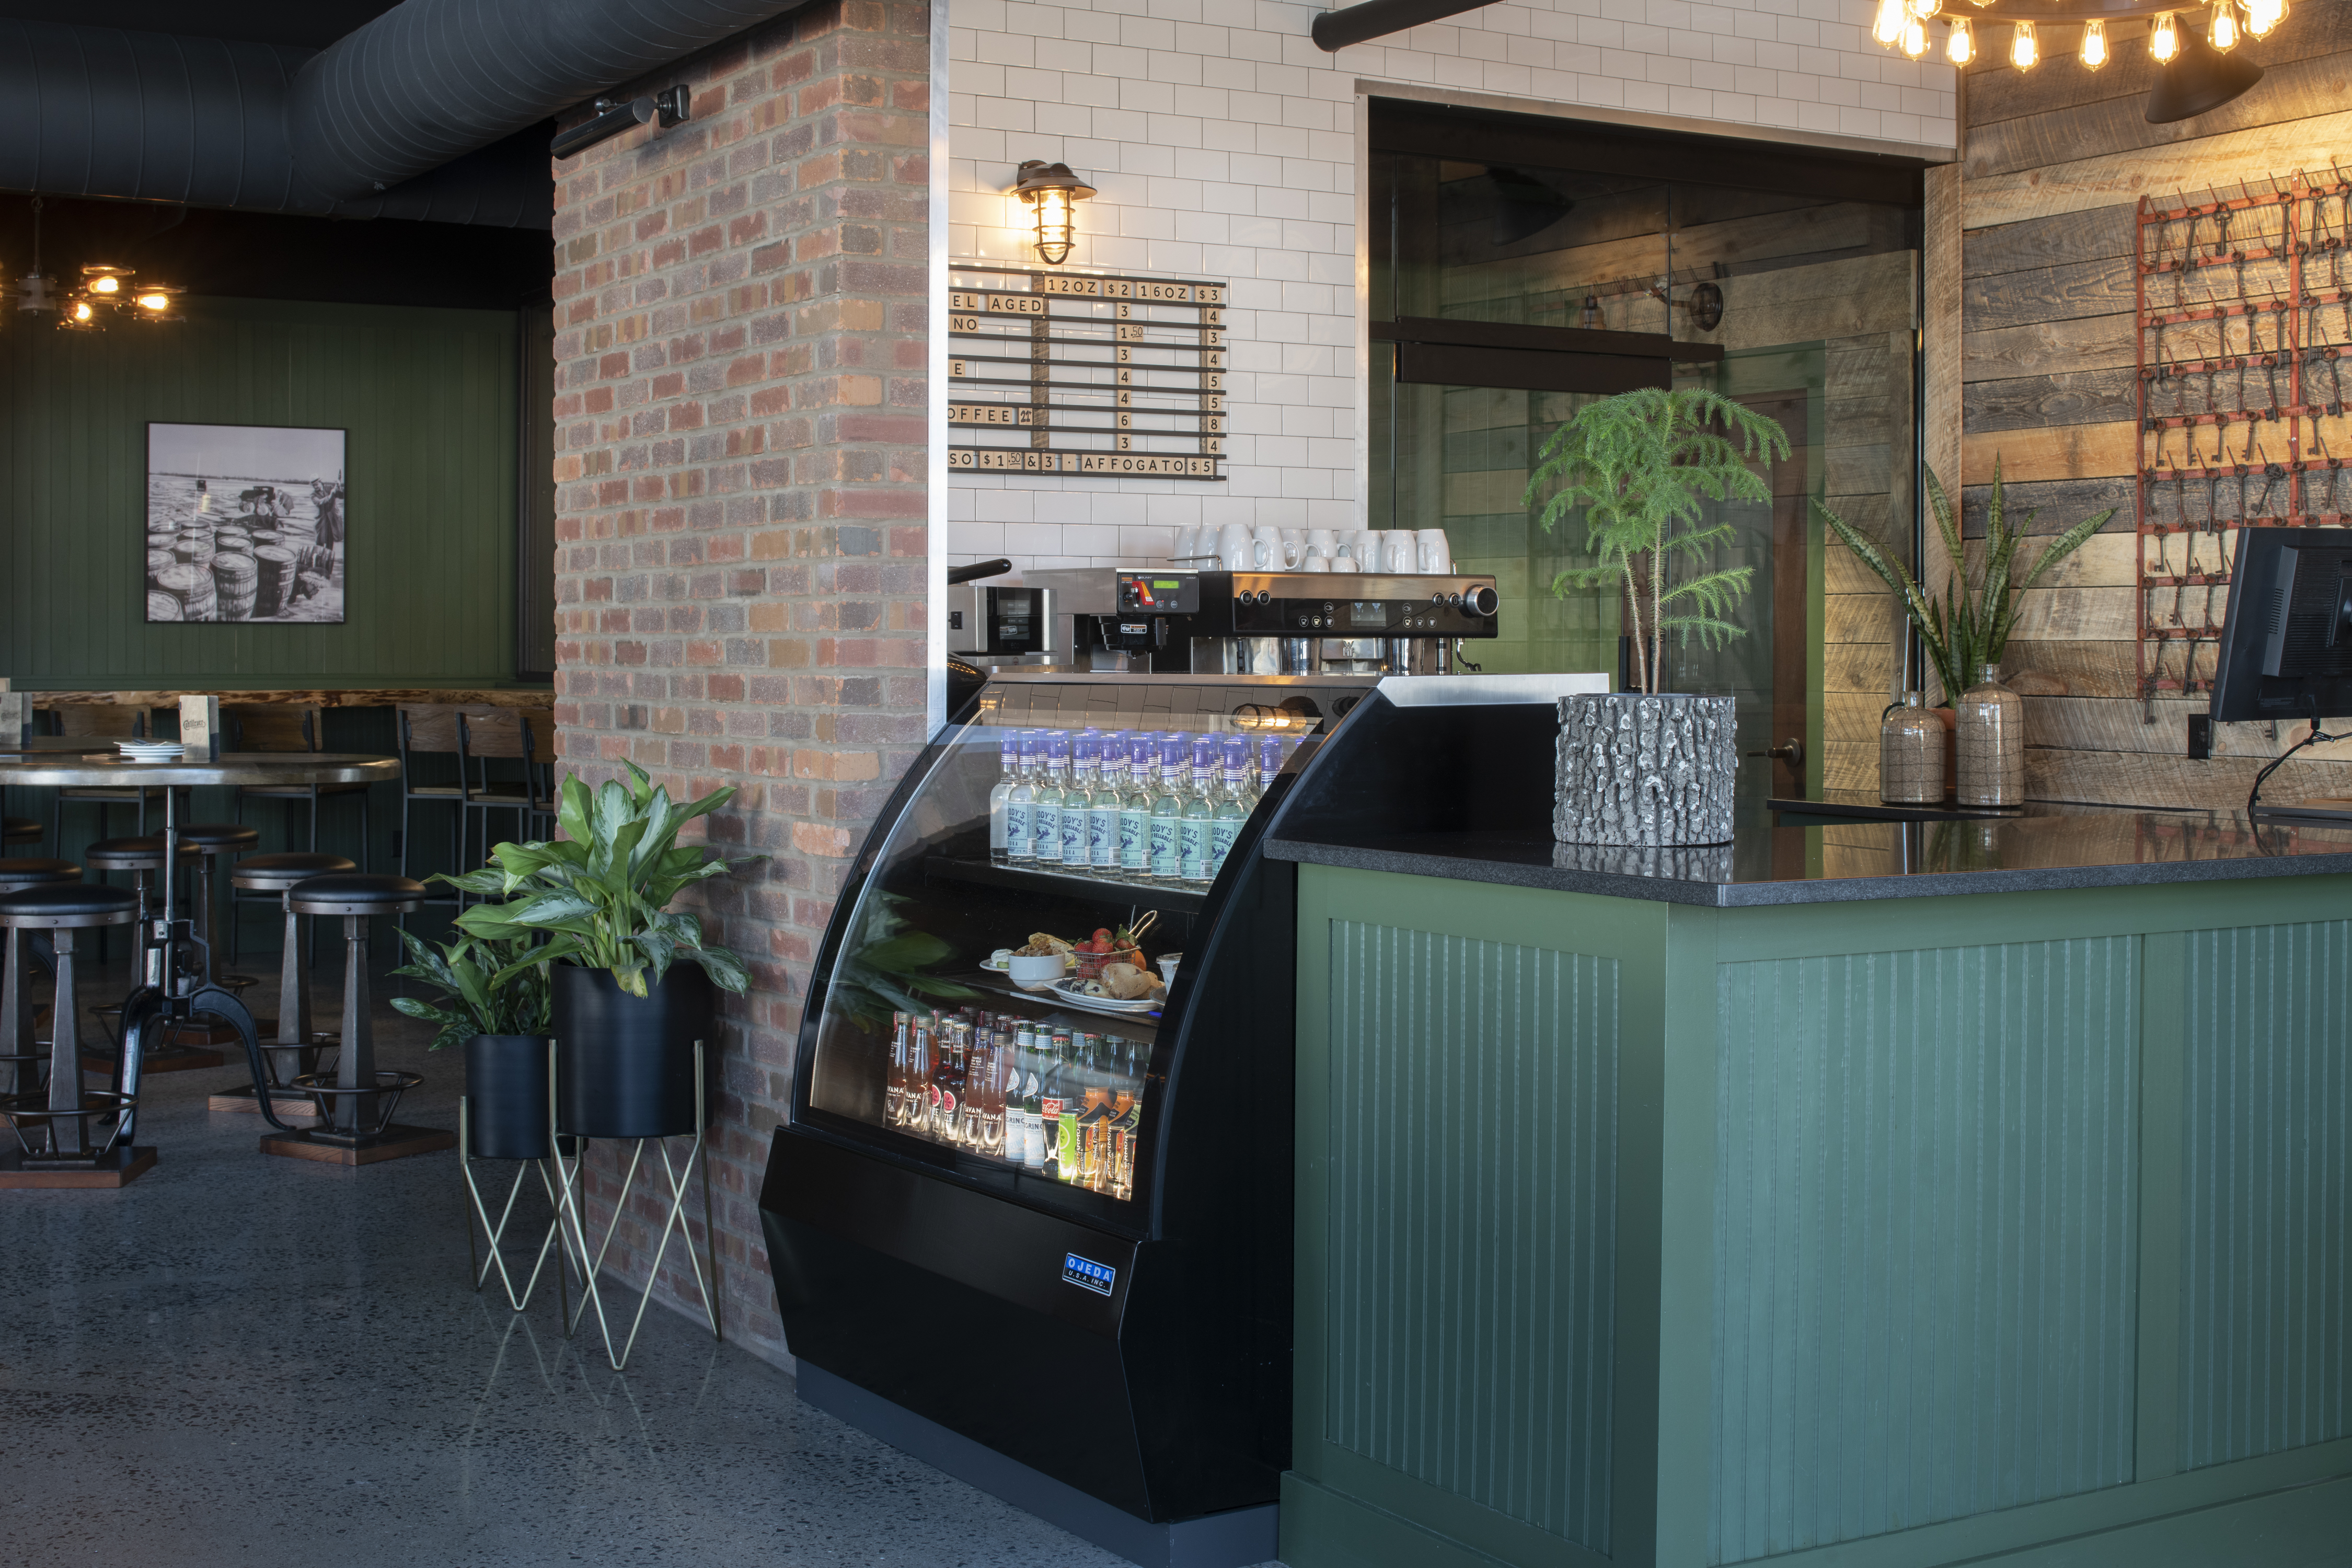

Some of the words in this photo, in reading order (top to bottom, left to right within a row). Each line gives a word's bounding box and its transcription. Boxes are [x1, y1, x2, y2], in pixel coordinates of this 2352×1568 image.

[1048, 279, 1096, 293] 12OZ
[1109, 284, 1128, 296] $2
[1140, 285, 1186, 299] 16OZ
[1199, 289, 1218, 301] $3
[991, 298, 1041, 312] AGED
[1121, 306, 1128, 317] 3
[1209, 311, 1217, 322] 4
[1210, 332, 1217, 343] 3
[1121, 350, 1127, 361] 3
[1210, 354, 1217, 365] 4
[1121, 371, 1128, 383] 4
[1210, 376, 1217, 387] 5
[1121, 393, 1128, 404] 4
[1211, 397, 1218, 408] 5
[1121, 415, 1128, 426] 6
[1210, 419, 1218, 430] 8
[1121, 437, 1128, 448] 3
[1210, 441, 1217, 452] 4
[1028, 456, 1036, 467] &
[1045, 456, 1052, 468] 3
[1084, 457, 1183, 471] AFFOGATO
[1009, 816, 1025, 826] RELIABLE
[1039, 819, 1056, 829] RELIABLE
[1065, 824, 1082, 834] RELIABLE
[1122, 827, 1139, 837] RELIABLE
[1154, 833, 1173, 843] RELIABLE
[1215, 836, 1232, 847] RELIABLE
[1068, 1258, 1110, 1282] OJEDA
[1068, 1270, 1089, 1282] U.S.A.
[1091, 1278, 1105, 1288] INC.
